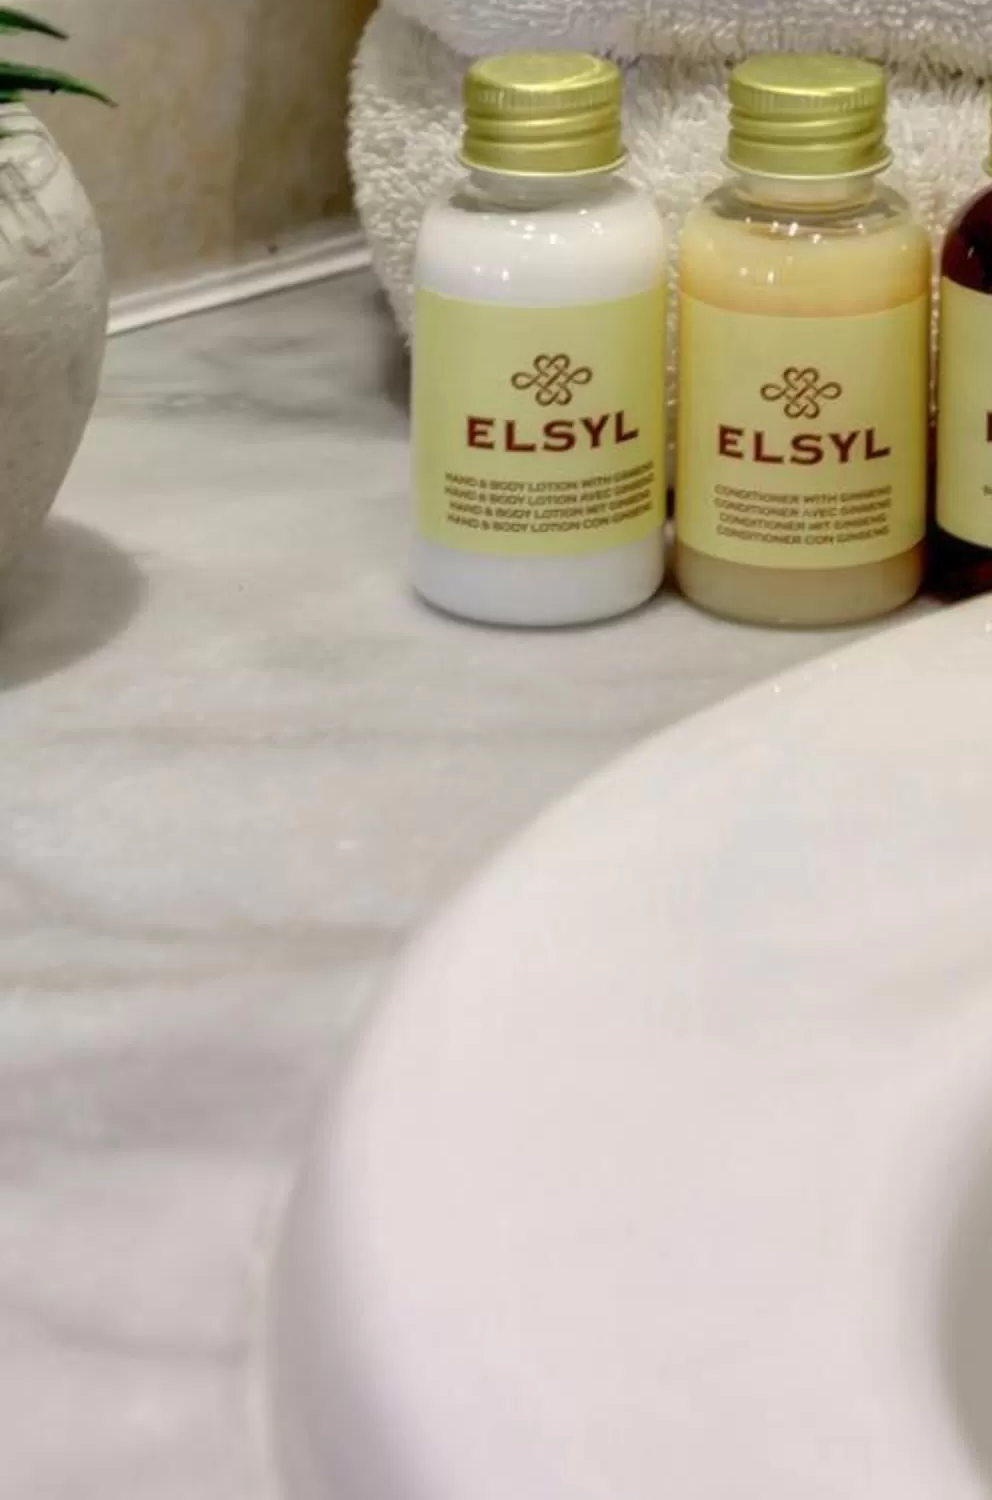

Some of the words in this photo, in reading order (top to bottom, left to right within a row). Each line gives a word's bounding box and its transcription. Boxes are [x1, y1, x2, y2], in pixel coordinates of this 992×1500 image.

[466, 409, 640, 453] ELSYL
[717, 422, 892, 466] ELSYL
[490, 480, 525, 492] BODY
[528, 480, 577, 493] LOTION
[581, 475, 611, 489] WITH
[714, 483, 799, 504] CONDITIONER
[803, 493, 837, 504] WITH
[490, 494, 525, 506] BODY
[528, 494, 577, 507] LOTION
[580, 487, 611, 503] AVEC
[496, 507, 531, 519] BODY
[534, 507, 583, 520] LOTION
[585, 503, 606, 515] MIT
[714, 497, 799, 517] CONDITIONER
[802, 507, 837, 518] AVEC
[493, 520, 528, 532] BODY
[531, 521, 580, 533] LOTION
[583, 517, 609, 530] CON
[719, 512, 805, 531] CONDITIONER
[808, 520, 830, 531] MIT
[716, 524, 802, 545] CONDITIONER
[805, 534, 834, 545] CON
